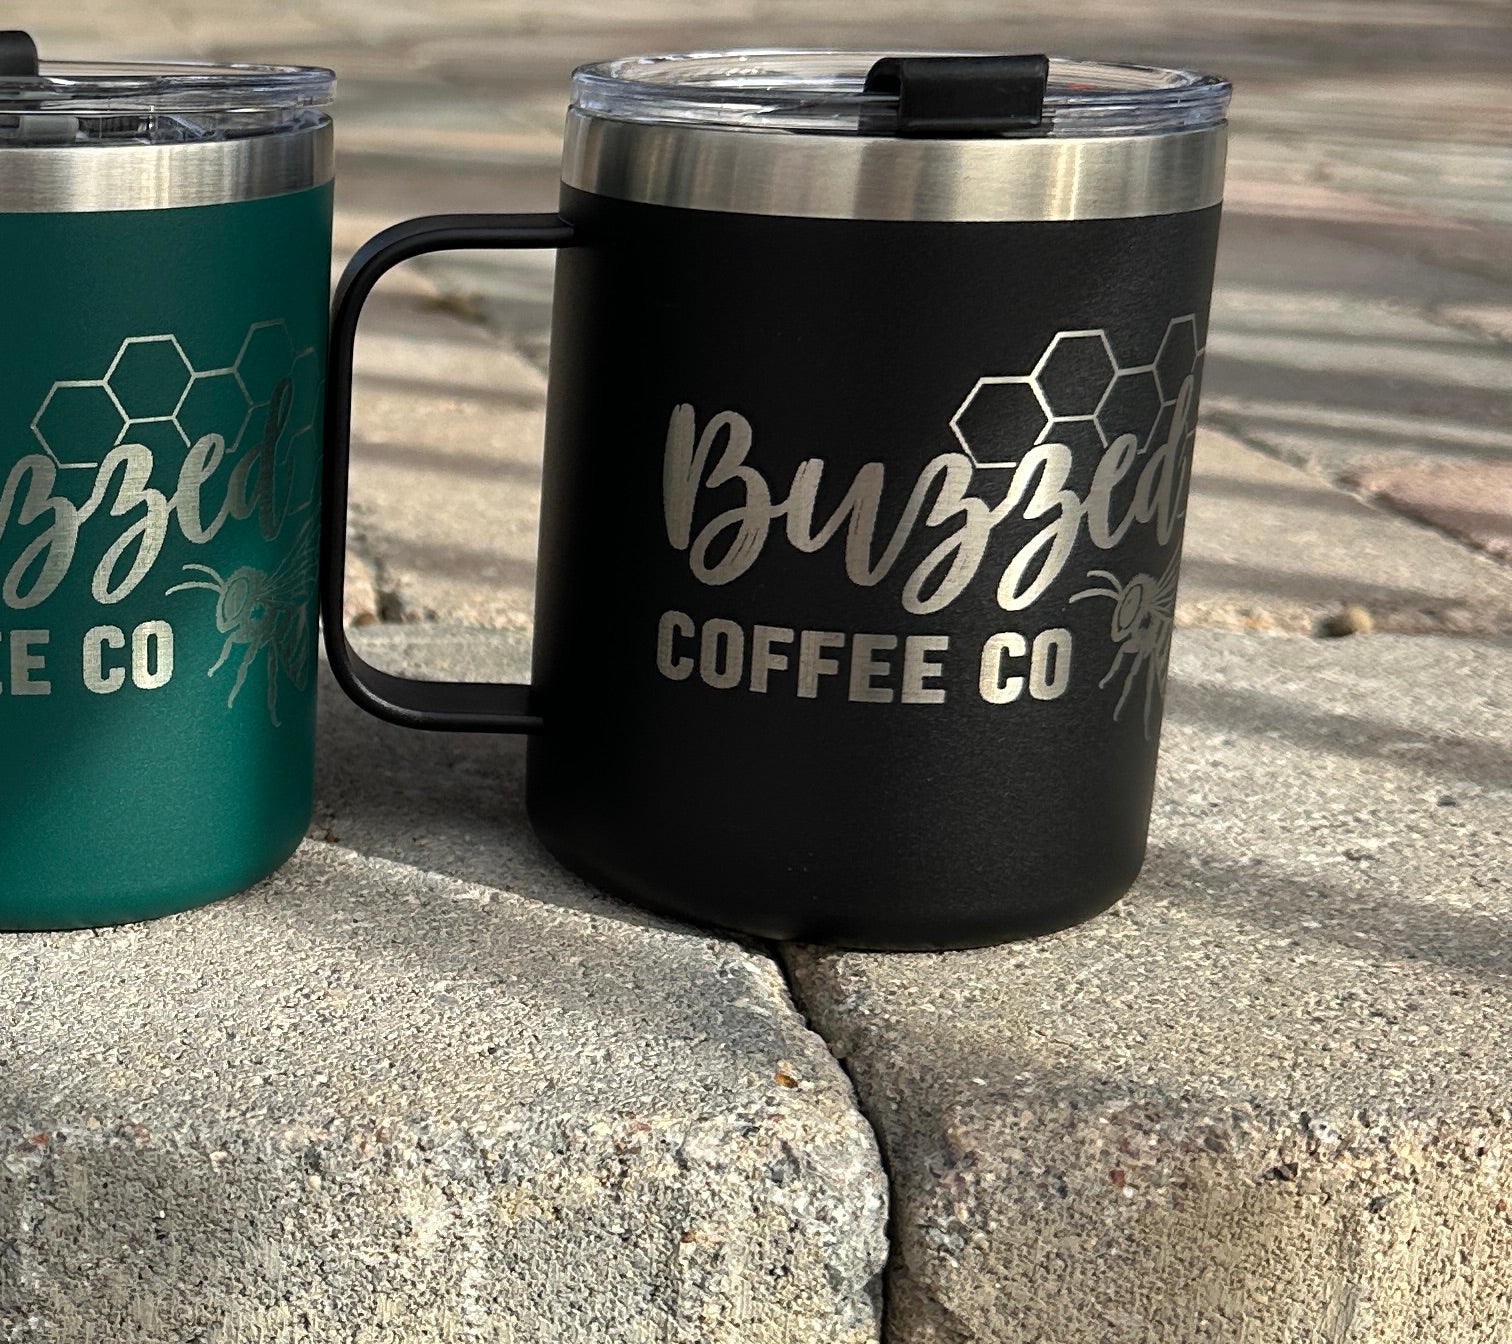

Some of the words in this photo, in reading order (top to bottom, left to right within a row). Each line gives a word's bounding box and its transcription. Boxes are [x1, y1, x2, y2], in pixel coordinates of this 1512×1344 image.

[663, 374, 1194, 615] Buzzed
[82, 619, 175, 695] CO
[657, 611, 950, 704] COFFEE
[978, 627, 1073, 705] CO
